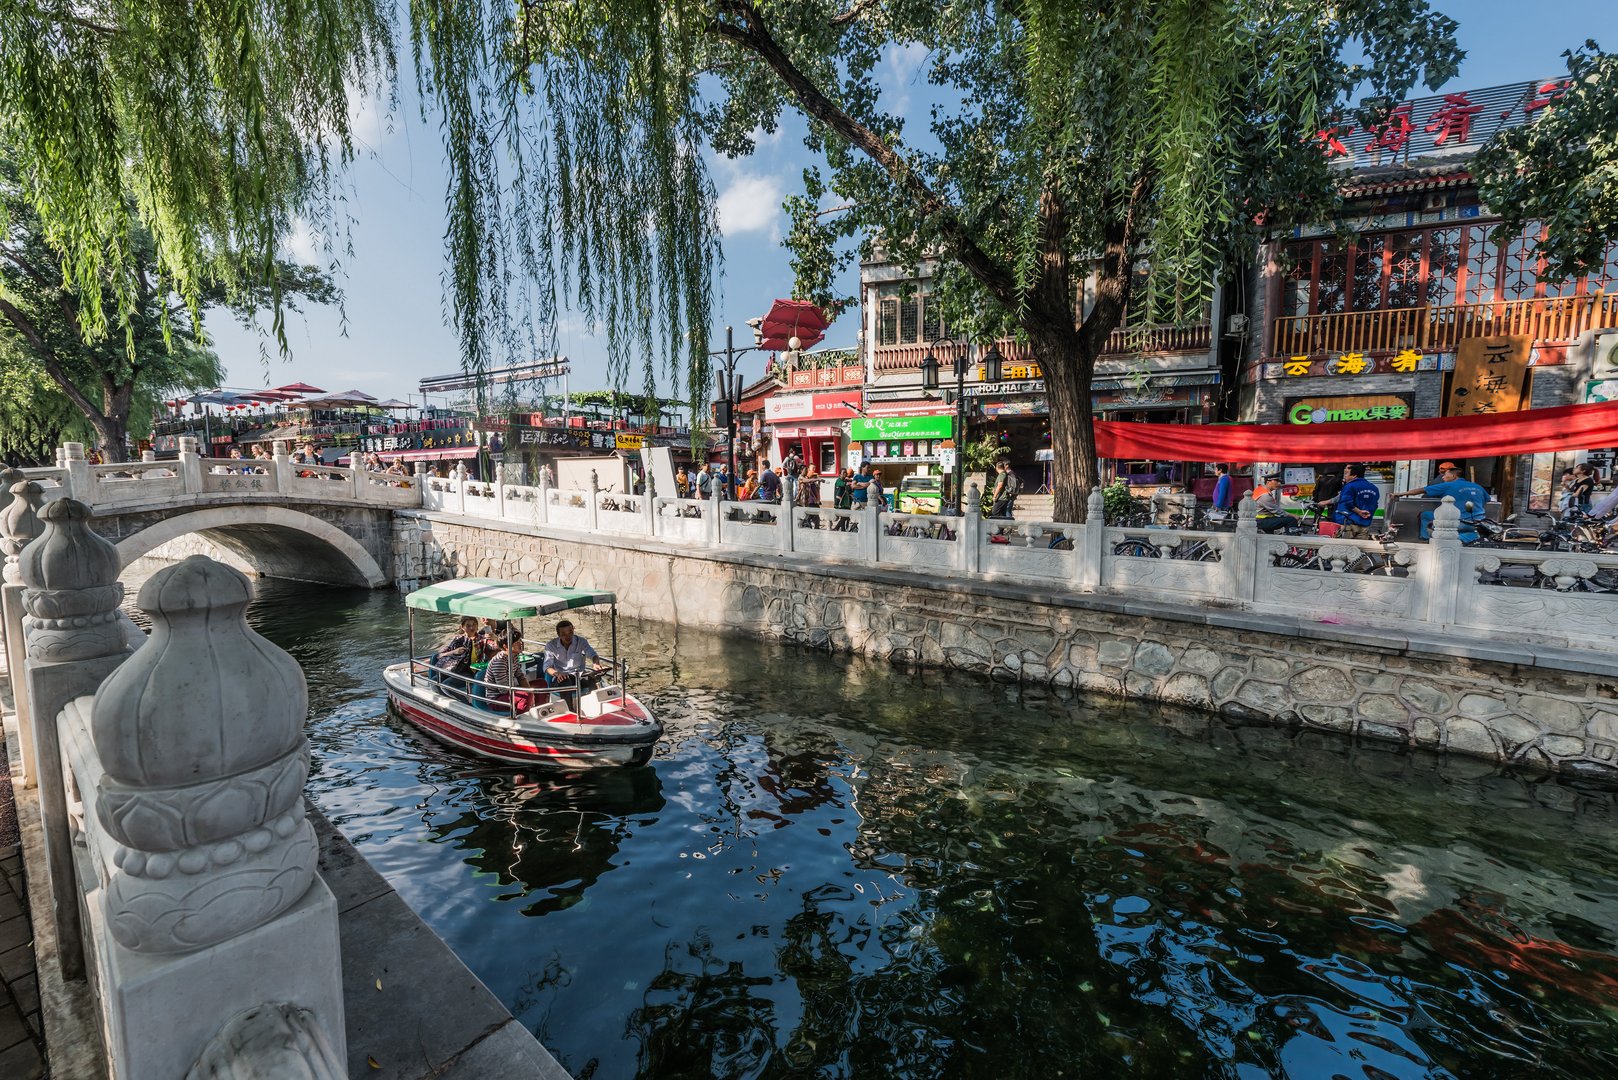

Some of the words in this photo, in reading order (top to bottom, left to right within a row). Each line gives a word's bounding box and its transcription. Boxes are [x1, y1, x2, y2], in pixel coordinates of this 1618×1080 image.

[1283, 349, 1424, 376] 云海肴
[979, 384, 999, 393] HOU
